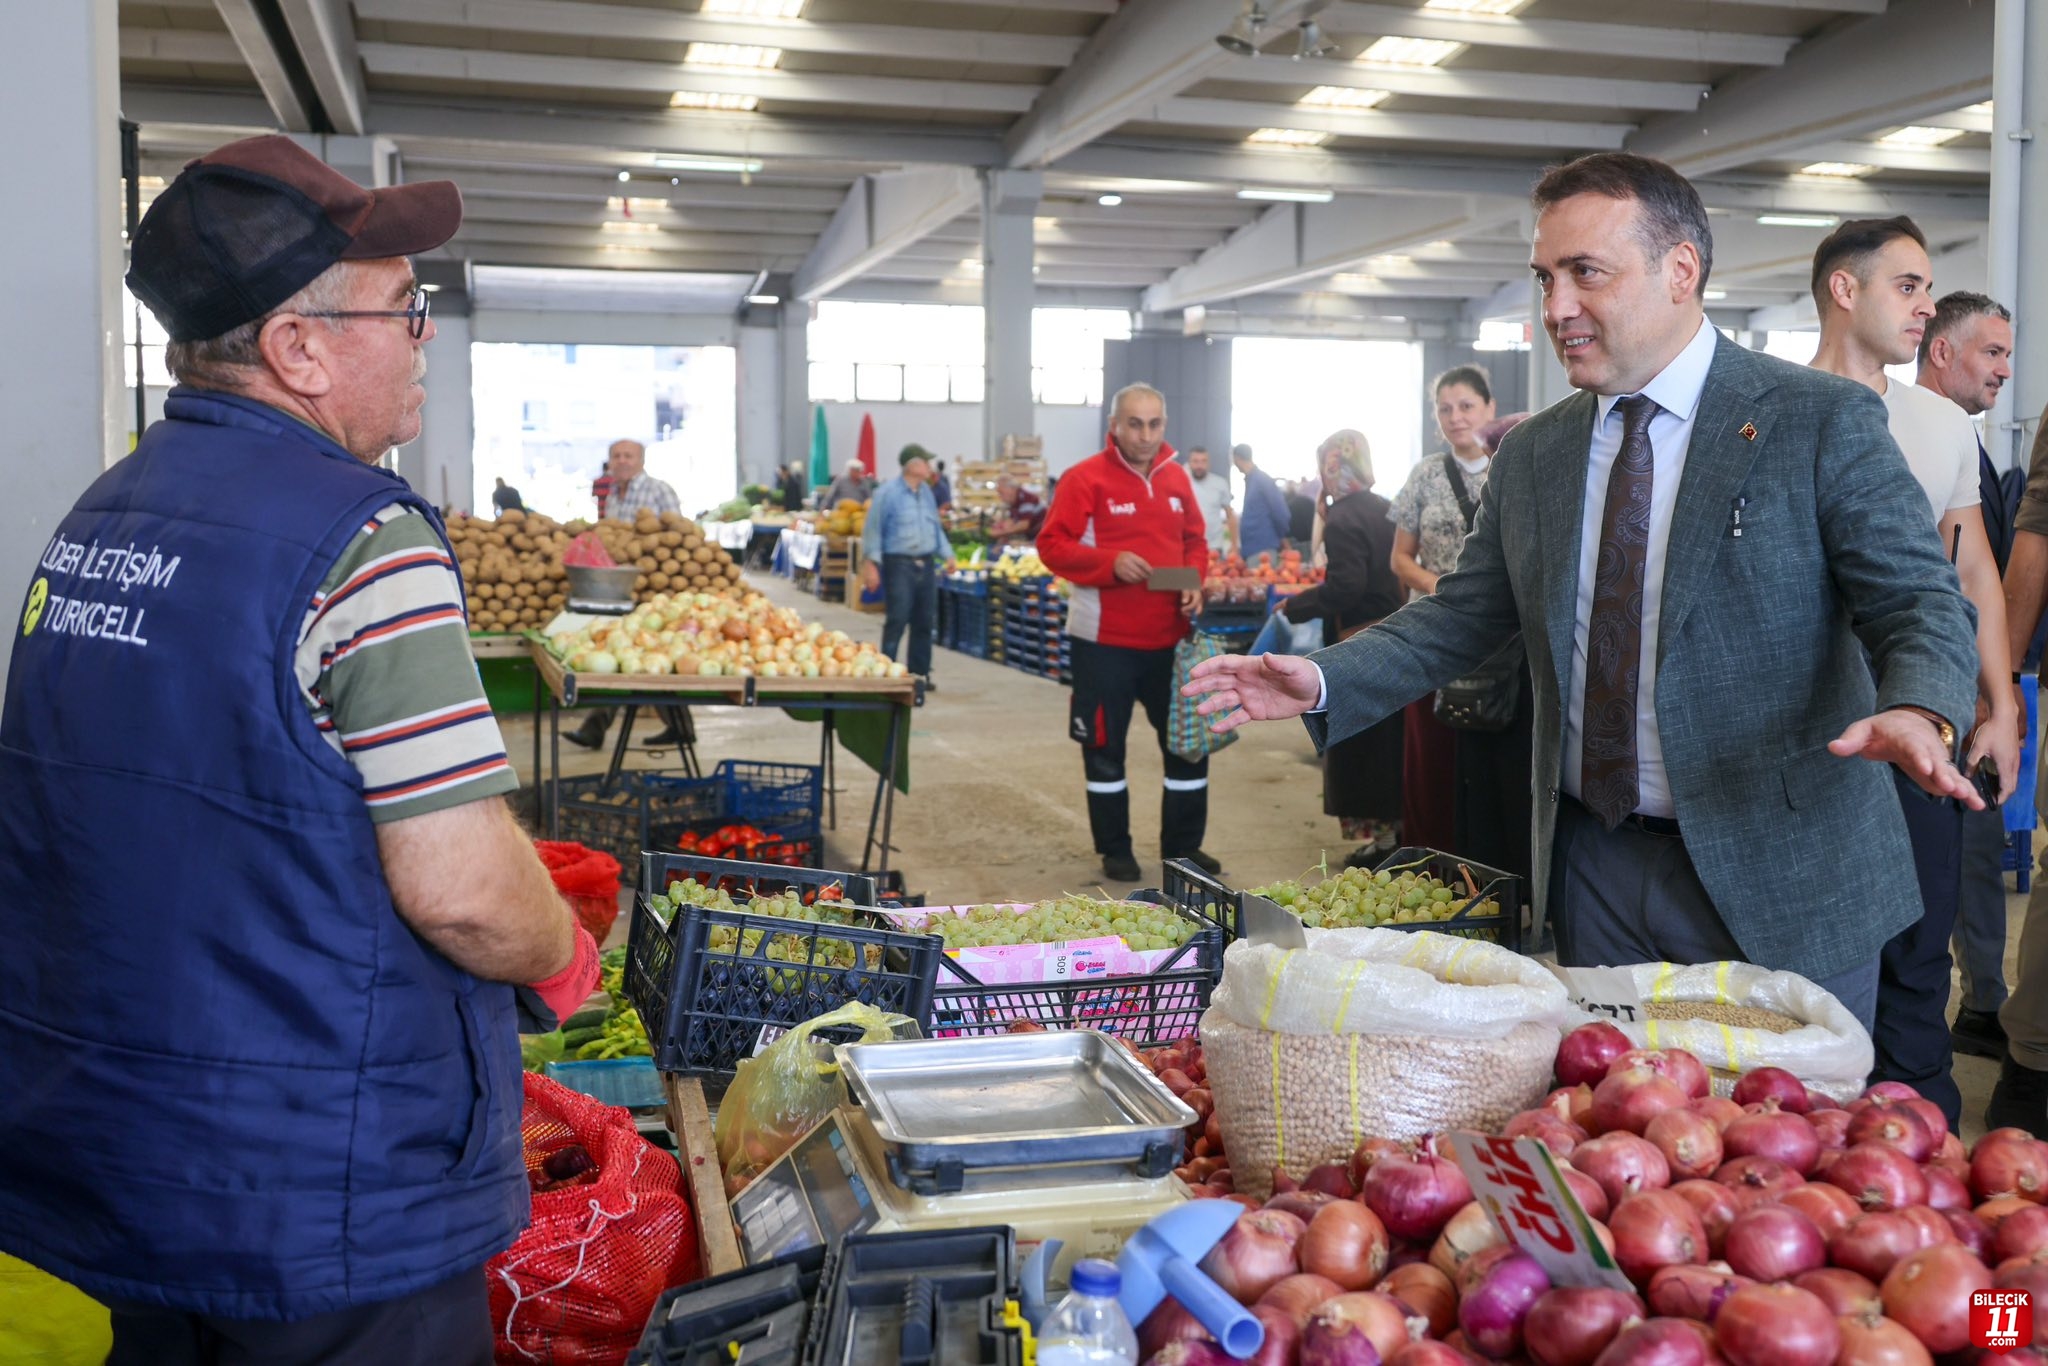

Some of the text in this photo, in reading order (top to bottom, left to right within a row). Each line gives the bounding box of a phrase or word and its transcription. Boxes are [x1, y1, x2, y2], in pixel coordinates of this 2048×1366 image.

[42, 533, 181, 592] LİDER İLETİŞİM
[44, 594, 148, 647] TURKCELL
